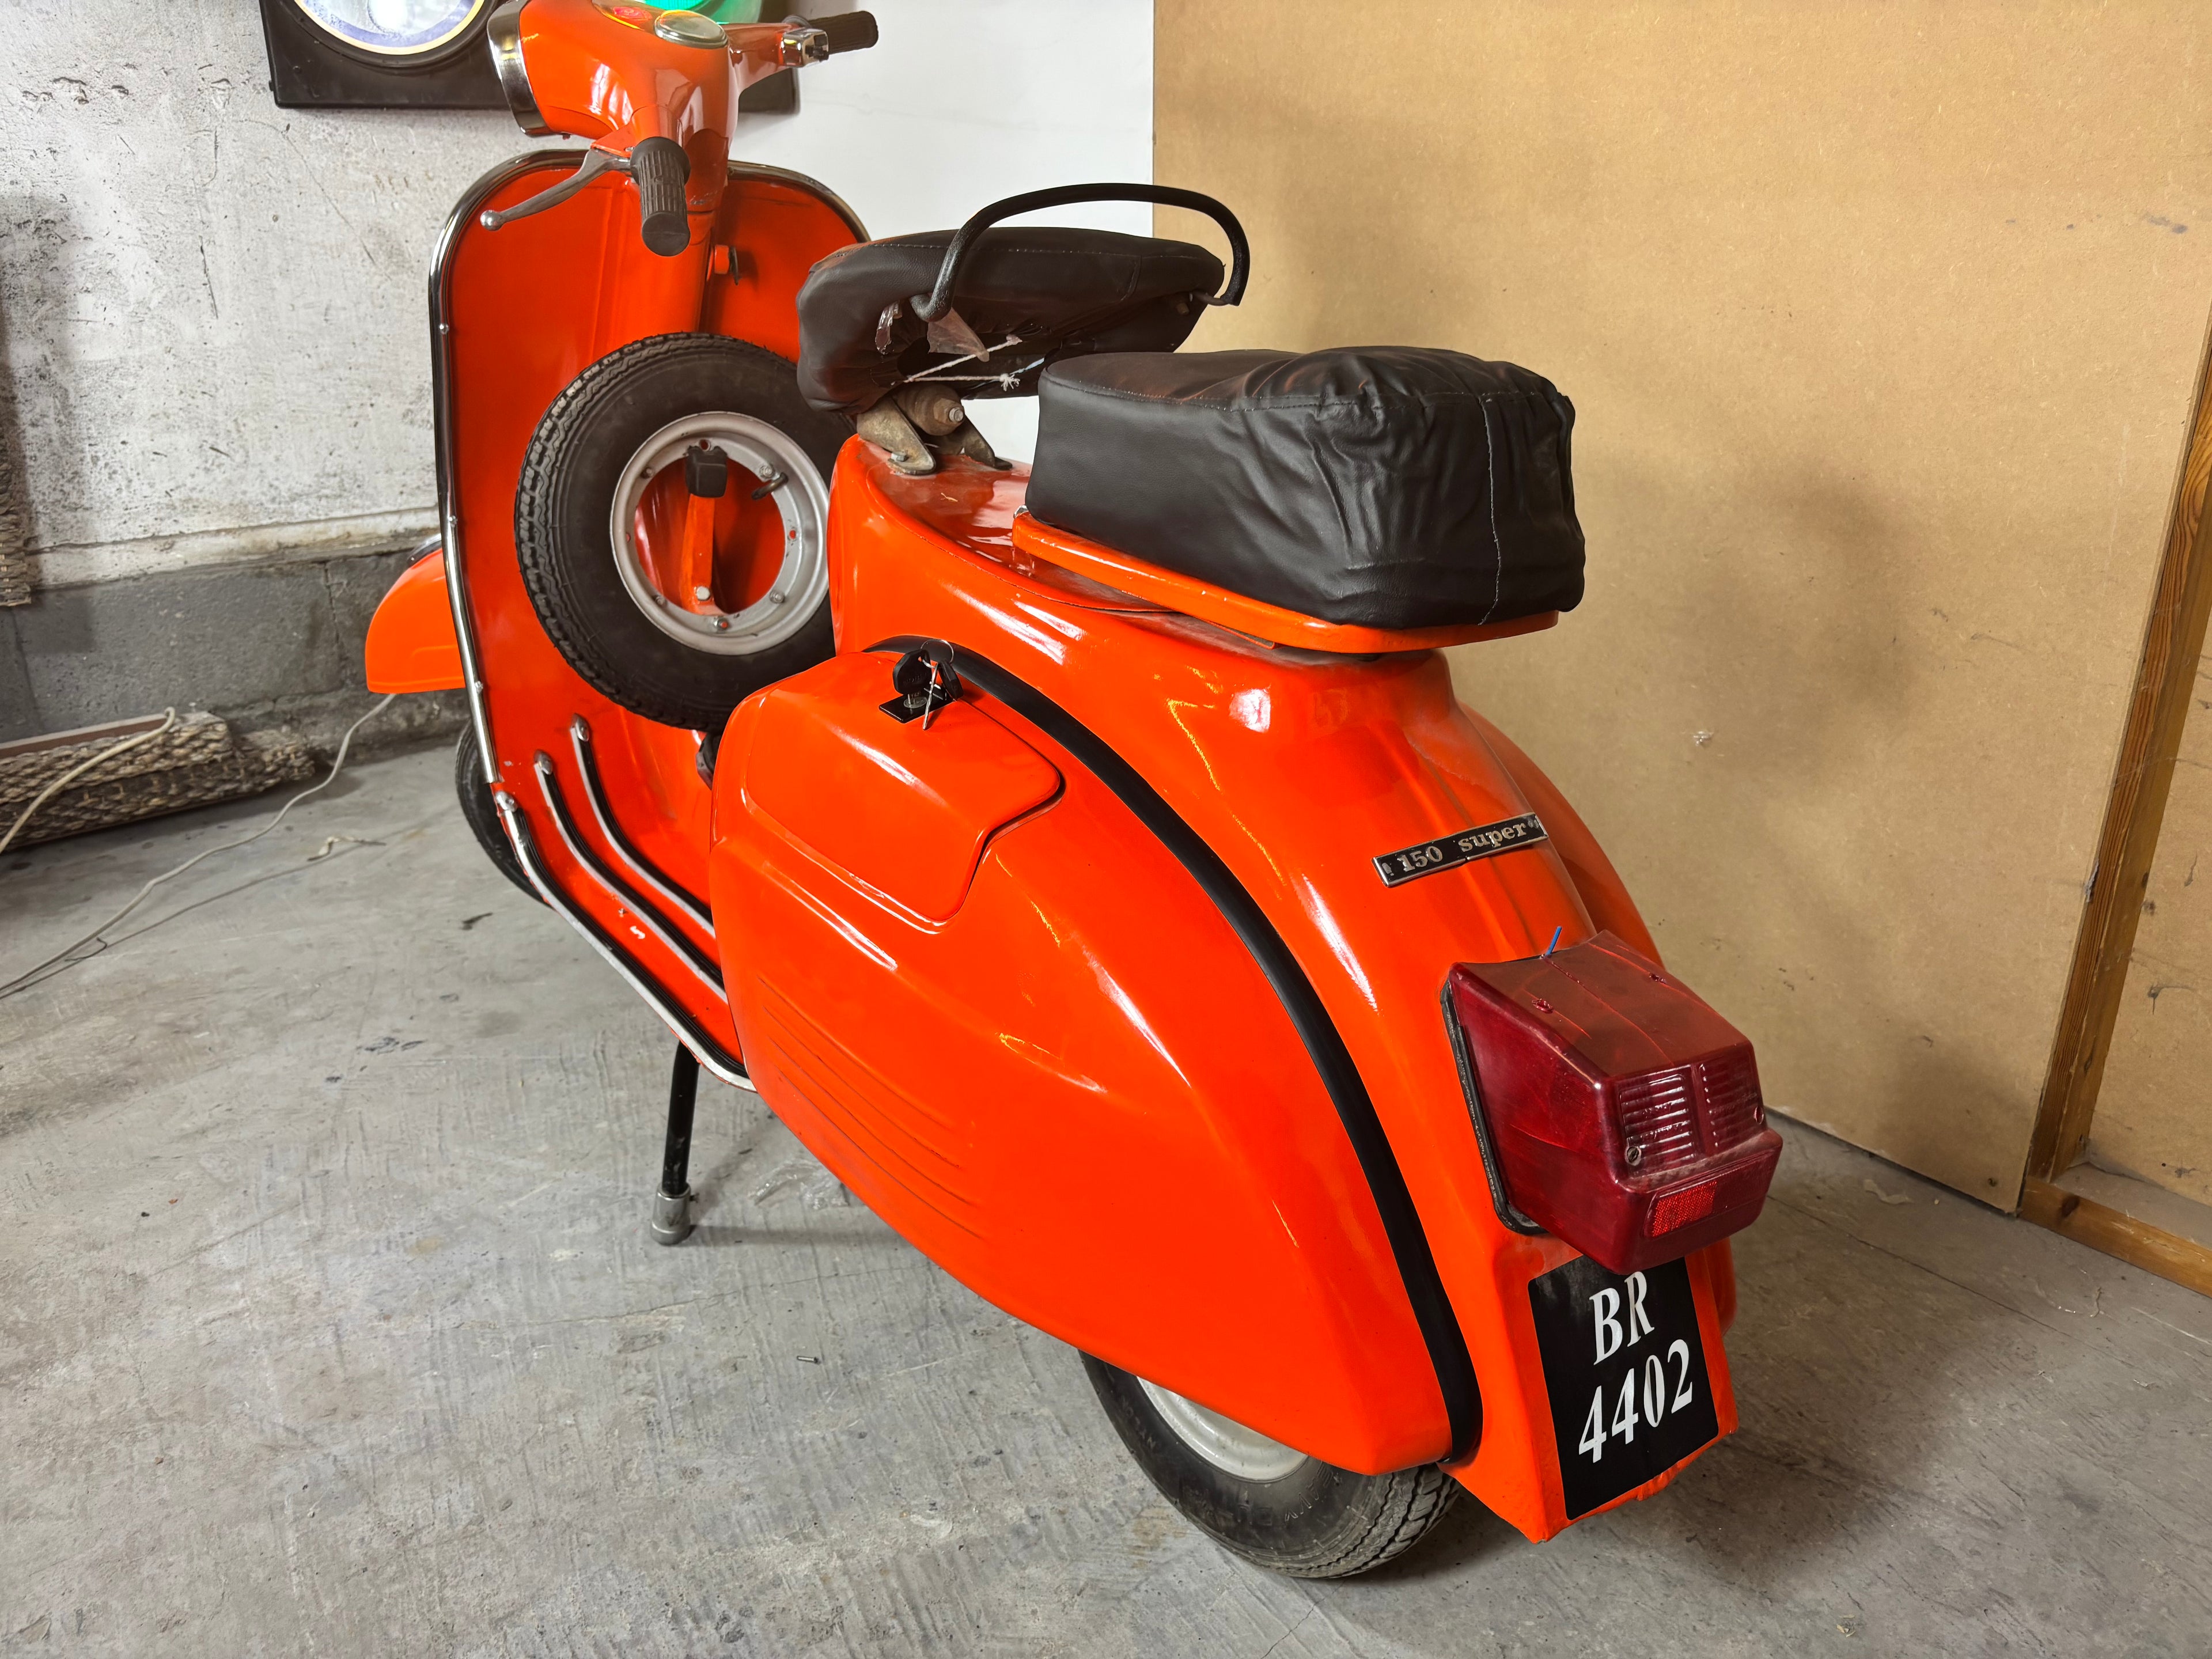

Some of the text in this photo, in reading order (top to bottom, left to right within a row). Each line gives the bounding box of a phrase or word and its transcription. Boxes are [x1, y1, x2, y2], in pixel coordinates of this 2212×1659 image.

[1397, 823, 1527, 872] 150 super
[1589, 1271, 1655, 1365] BR
[1578, 1339, 1692, 1463] 4402
